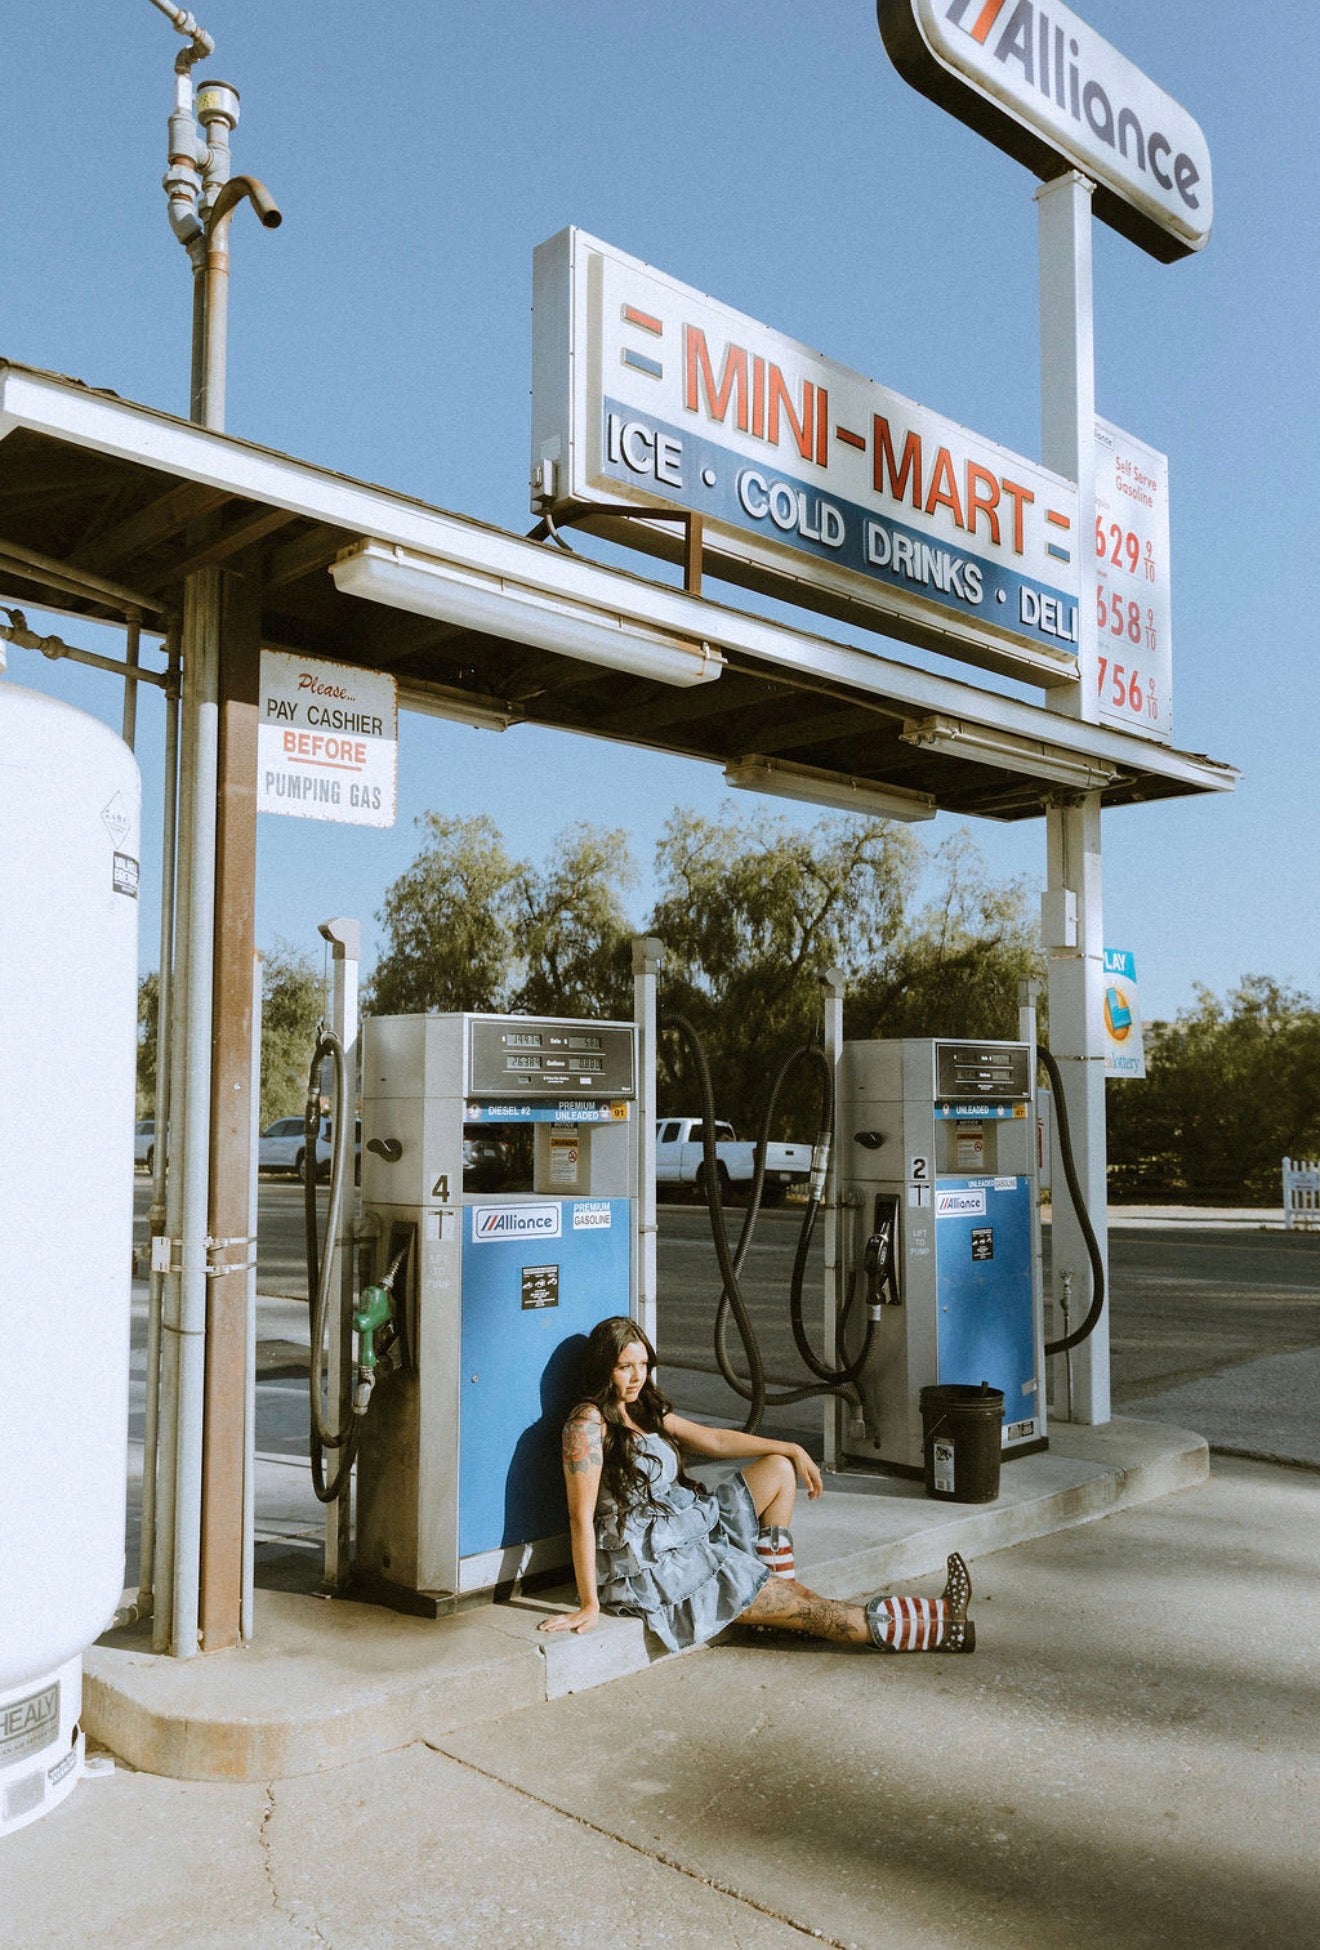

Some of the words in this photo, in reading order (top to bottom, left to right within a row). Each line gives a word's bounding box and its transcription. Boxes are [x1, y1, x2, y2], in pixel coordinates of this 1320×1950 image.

[994, 0, 1200, 210] Alliance
[684, 322, 1035, 556] MINI-MART
[1115, 456, 1131, 475] Self
[1133, 466, 1157, 492] Serve
[1115, 475, 1153, 508] Gasoline
[607, 413, 683, 489] ICE
[736, 469, 845, 548] COLD
[867, 521, 984, 605] DRINKS
[1020, 585, 1077, 642] DELI
[267, 697, 298, 721] PAY
[307, 705, 383, 736] CASHIER
[283, 730, 367, 764] BEFORE
[265, 771, 341, 804] PUMPING
[351, 782, 382, 810] GAS
[1104, 951, 1126, 971] LAY
[488, 1106, 519, 1116] DIESEL
[555, 1111, 599, 1121] UNLEADED
[558, 1101, 596, 1111] PREMIUM
[614, 1109, 625, 1117] 91
[956, 1104, 990, 1114] UNLEADED
[913, 1158, 926, 1179] 2
[432, 1174, 450, 1203] 4
[574, 1202, 611, 1212] PREMIUM
[494, 1214, 553, 1231] Alliance
[575, 1214, 610, 1226] GASOLINE
